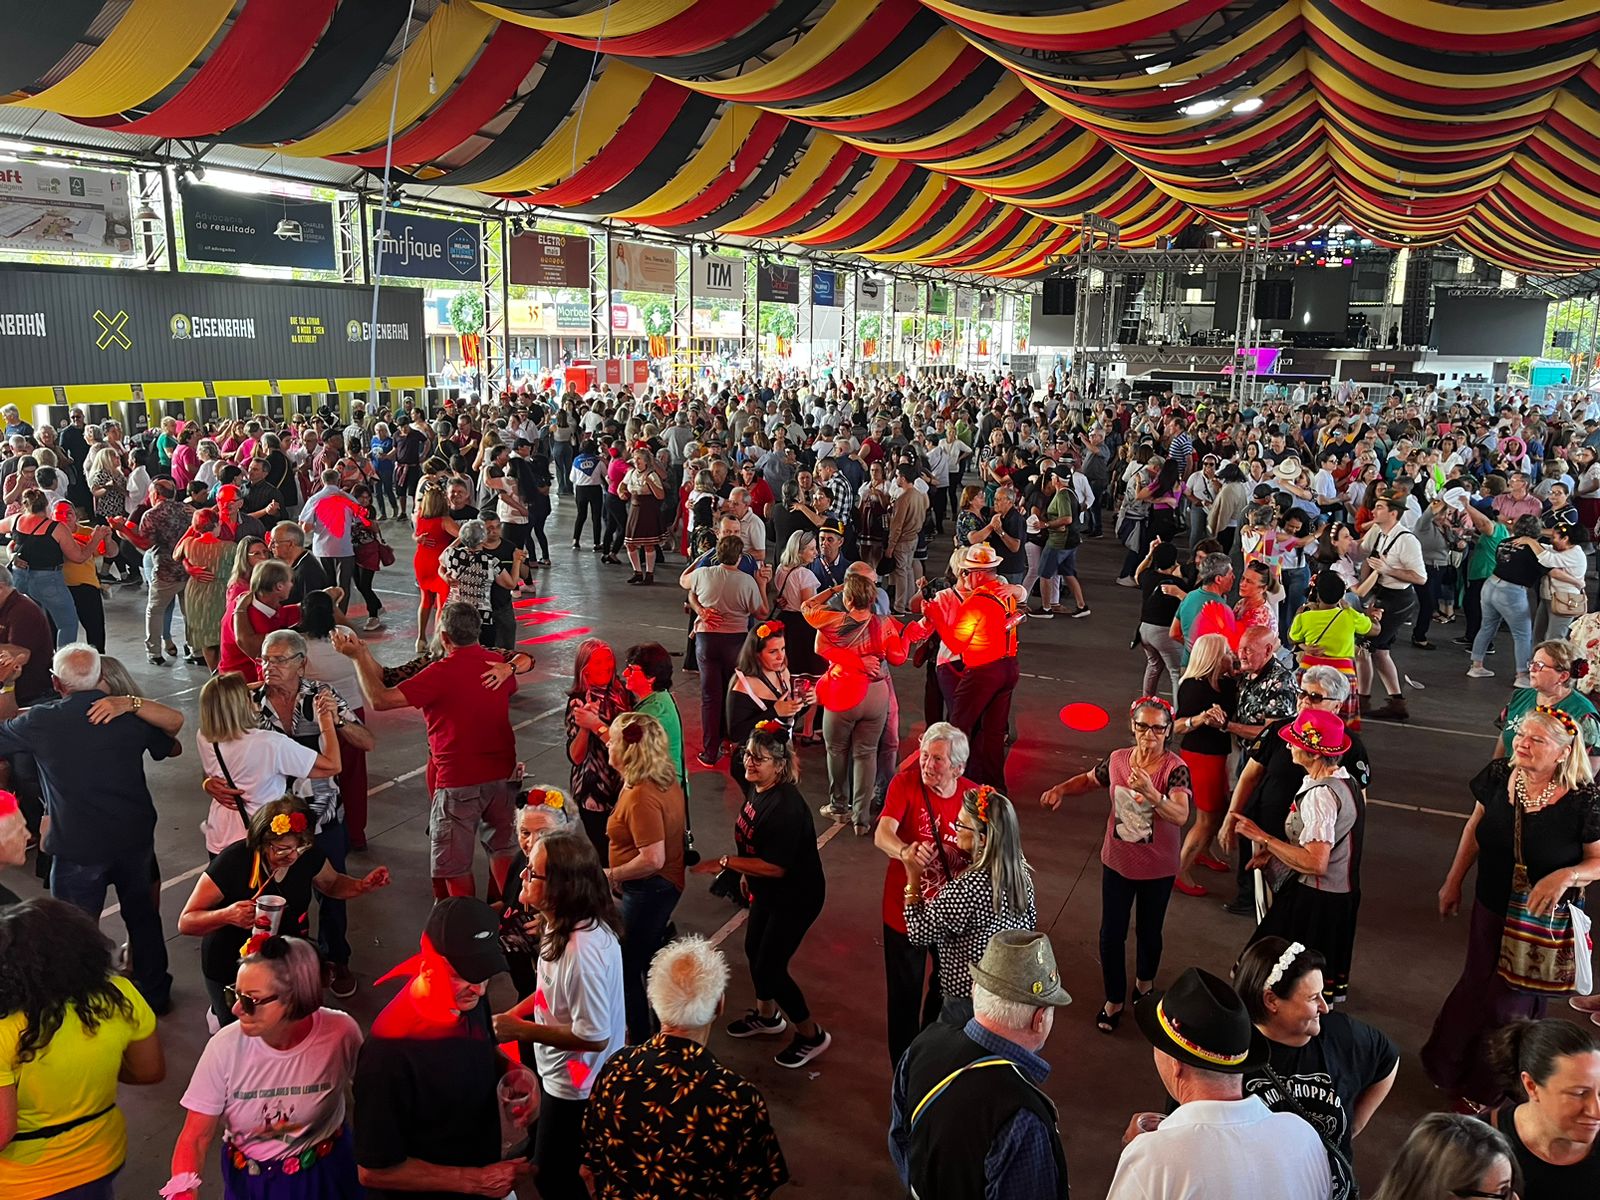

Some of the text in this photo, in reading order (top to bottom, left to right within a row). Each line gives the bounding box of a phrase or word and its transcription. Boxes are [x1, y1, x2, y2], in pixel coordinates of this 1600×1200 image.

[194, 211, 243, 223] Advocacia
[196, 222, 256, 235] de resultado
[706, 262, 732, 287] ITM
[191, 316, 255, 339] EISENBAHN
[363, 322, 409, 341] EIENBAHN
